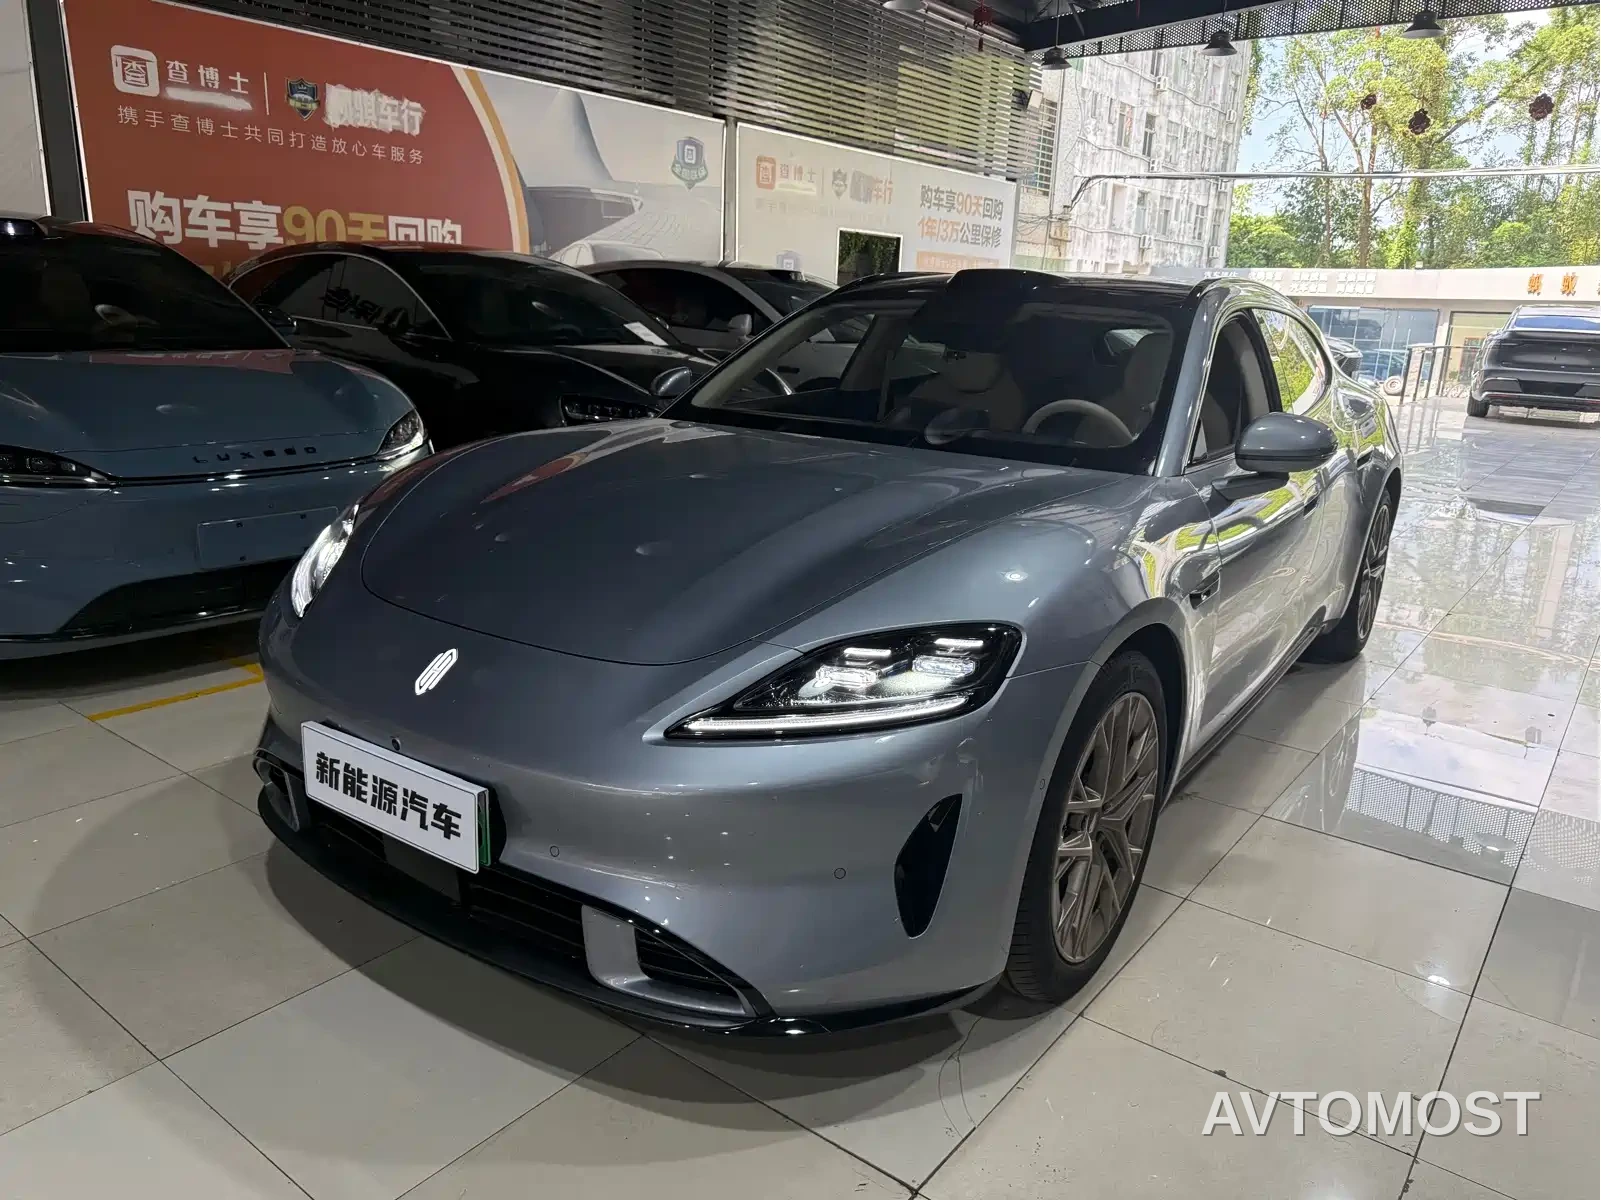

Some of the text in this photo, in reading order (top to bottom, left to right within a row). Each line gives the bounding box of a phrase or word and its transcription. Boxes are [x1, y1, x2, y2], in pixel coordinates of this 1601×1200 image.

[166, 59, 249, 94] 查博士
[117, 105, 424, 165] 携手查博士共同打造放心车服务
[127, 189, 462, 251] 购车享90天回购
[919, 183, 1004, 221] 购车享90天回购
[917, 215, 1003, 249] 1年/3万公里保修
[1528, 272, 1600, 297] 蚂蚁
[315, 751, 462, 840] 新能源汽车
